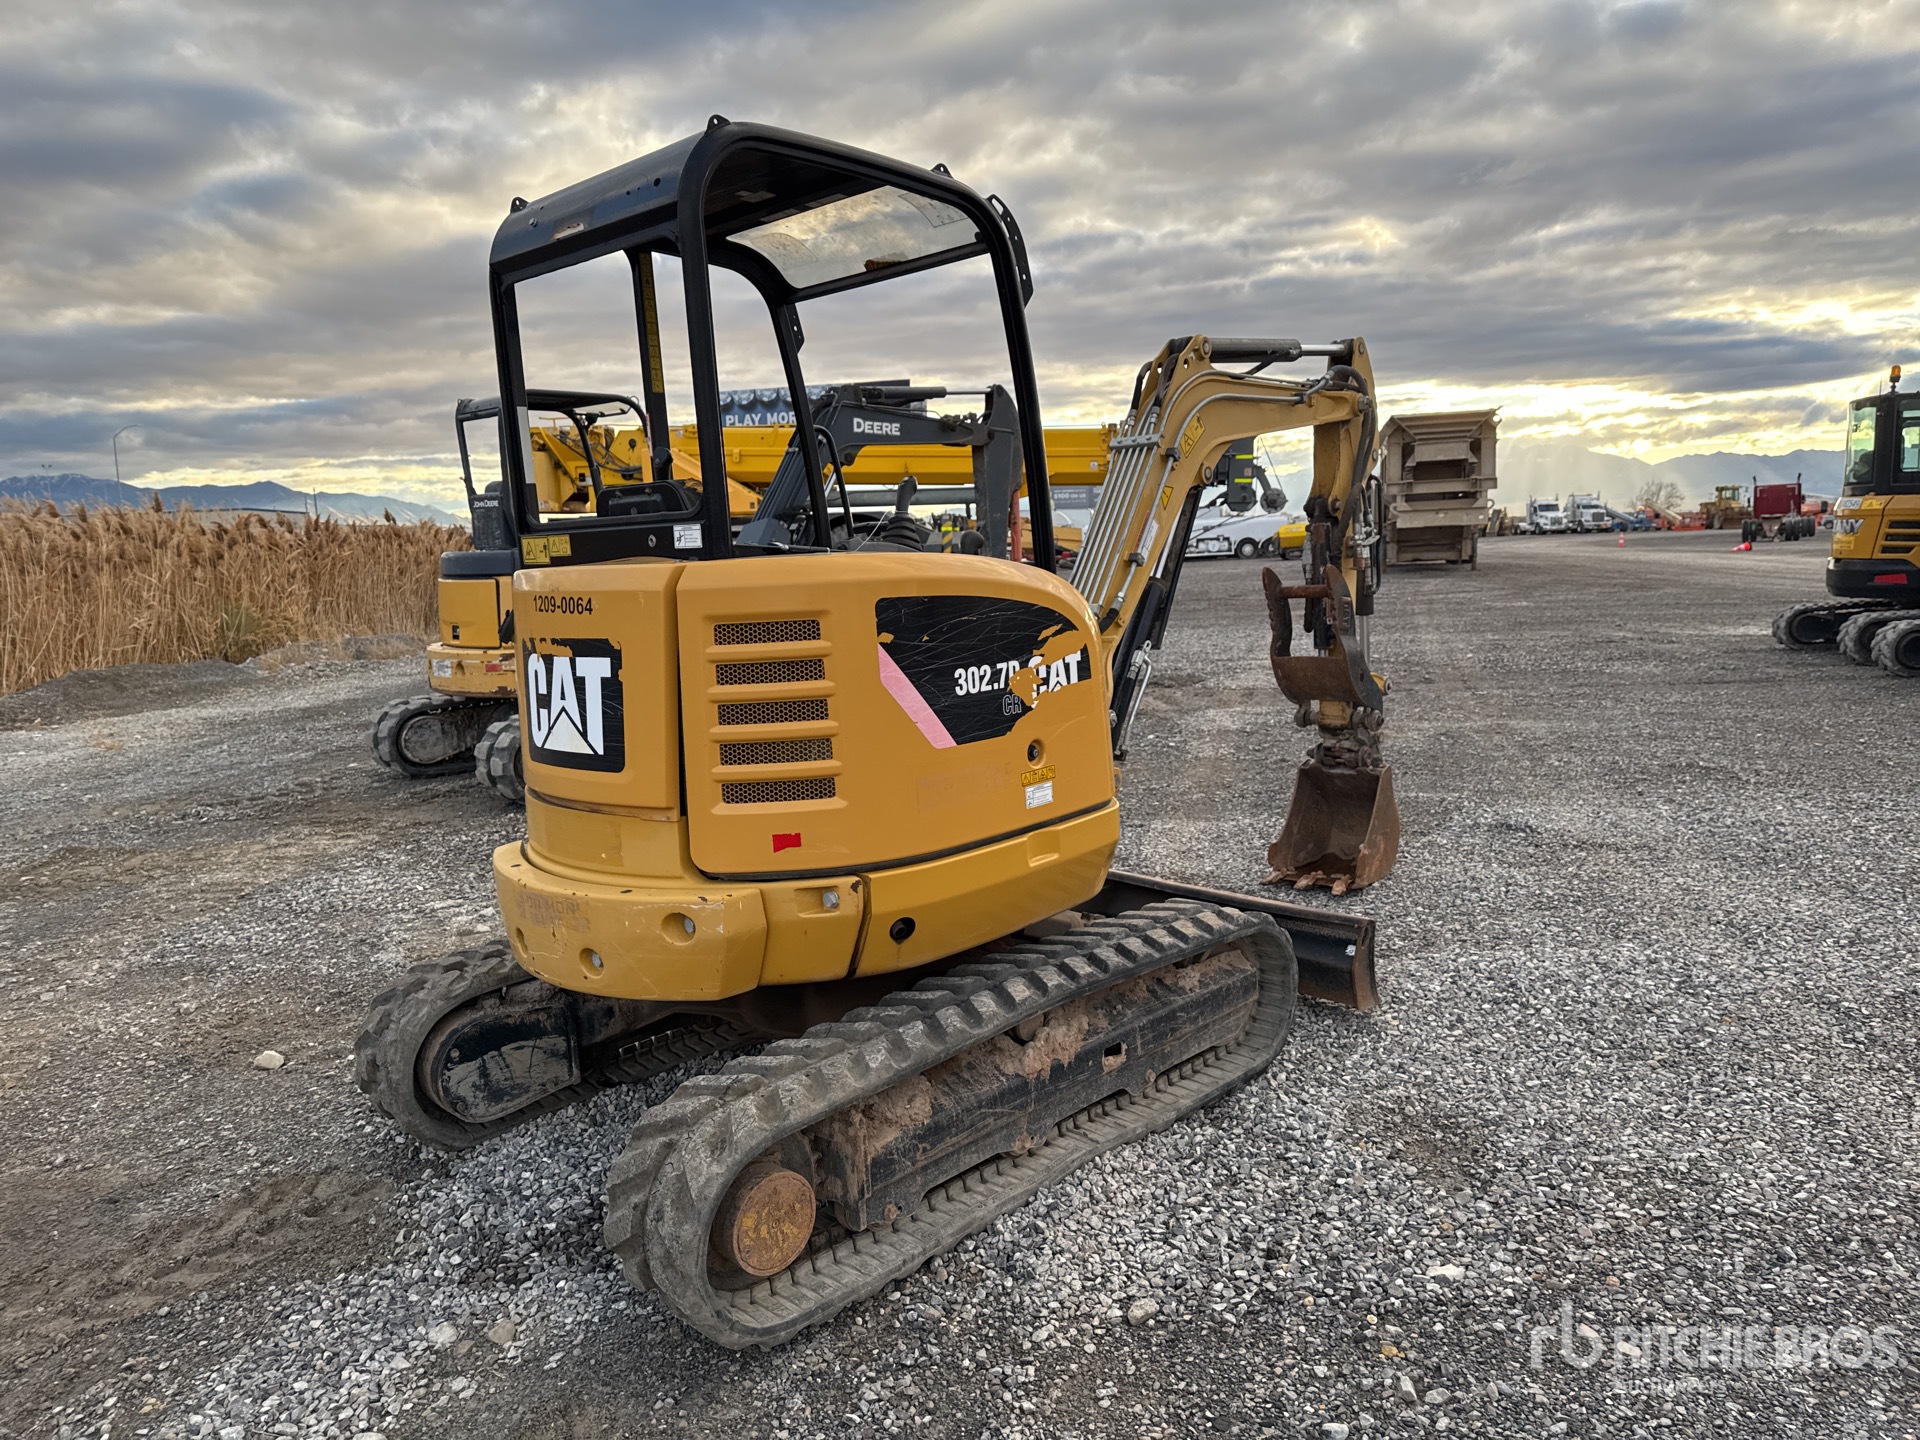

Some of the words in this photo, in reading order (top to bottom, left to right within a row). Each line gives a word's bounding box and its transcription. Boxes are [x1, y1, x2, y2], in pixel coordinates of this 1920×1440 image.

[725, 413, 761, 426] PLAY
[853, 418, 901, 436] DEERE
[533, 595, 593, 615] 1209-0064
[527, 653, 611, 755] CAT
